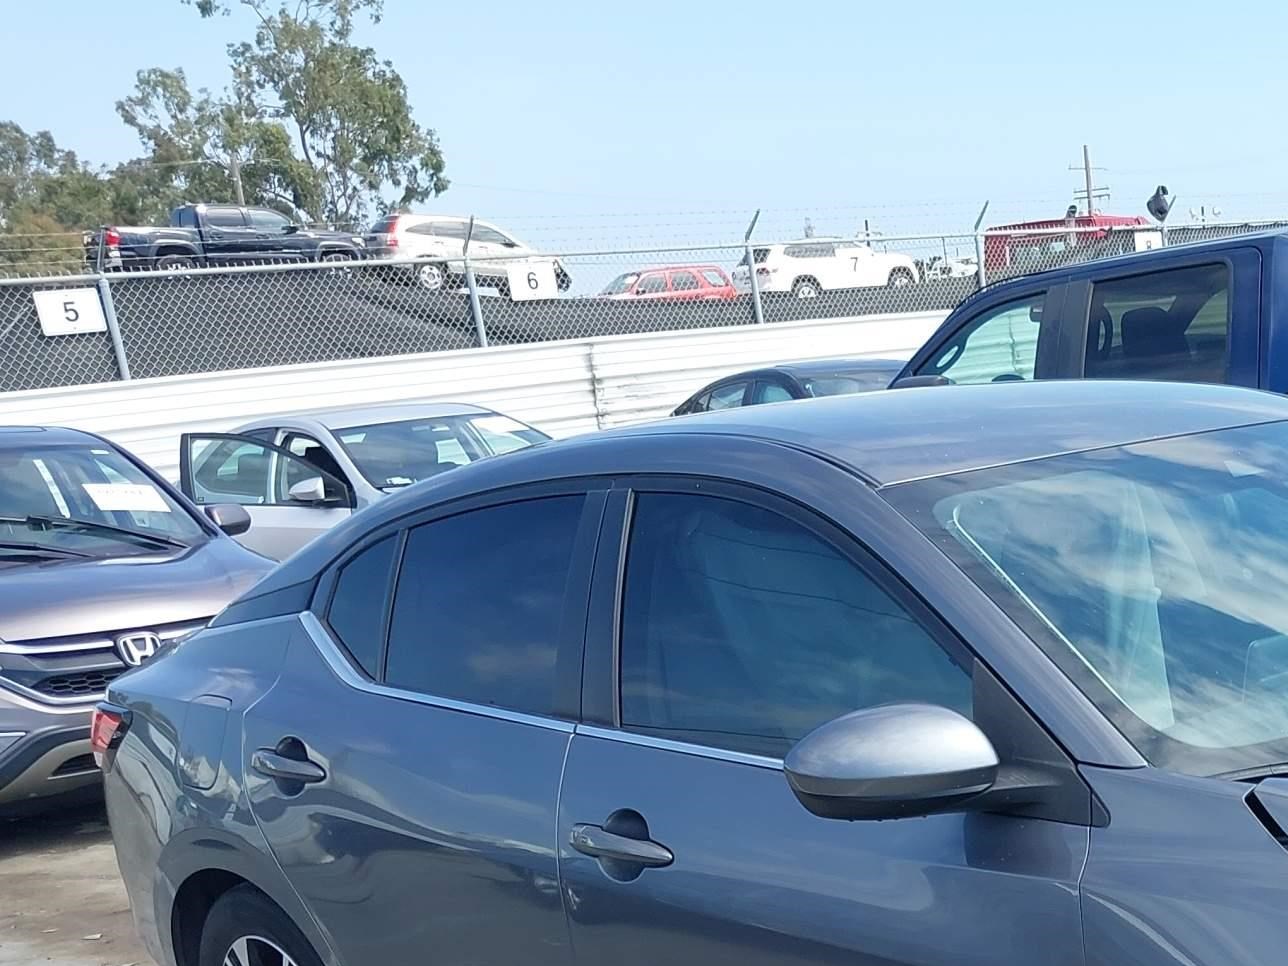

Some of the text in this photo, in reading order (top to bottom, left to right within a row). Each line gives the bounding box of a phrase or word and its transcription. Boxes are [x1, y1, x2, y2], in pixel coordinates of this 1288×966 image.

[850, 256, 858, 272] 7
[527, 271, 539, 290] 6
[63, 301, 79, 322] 5
